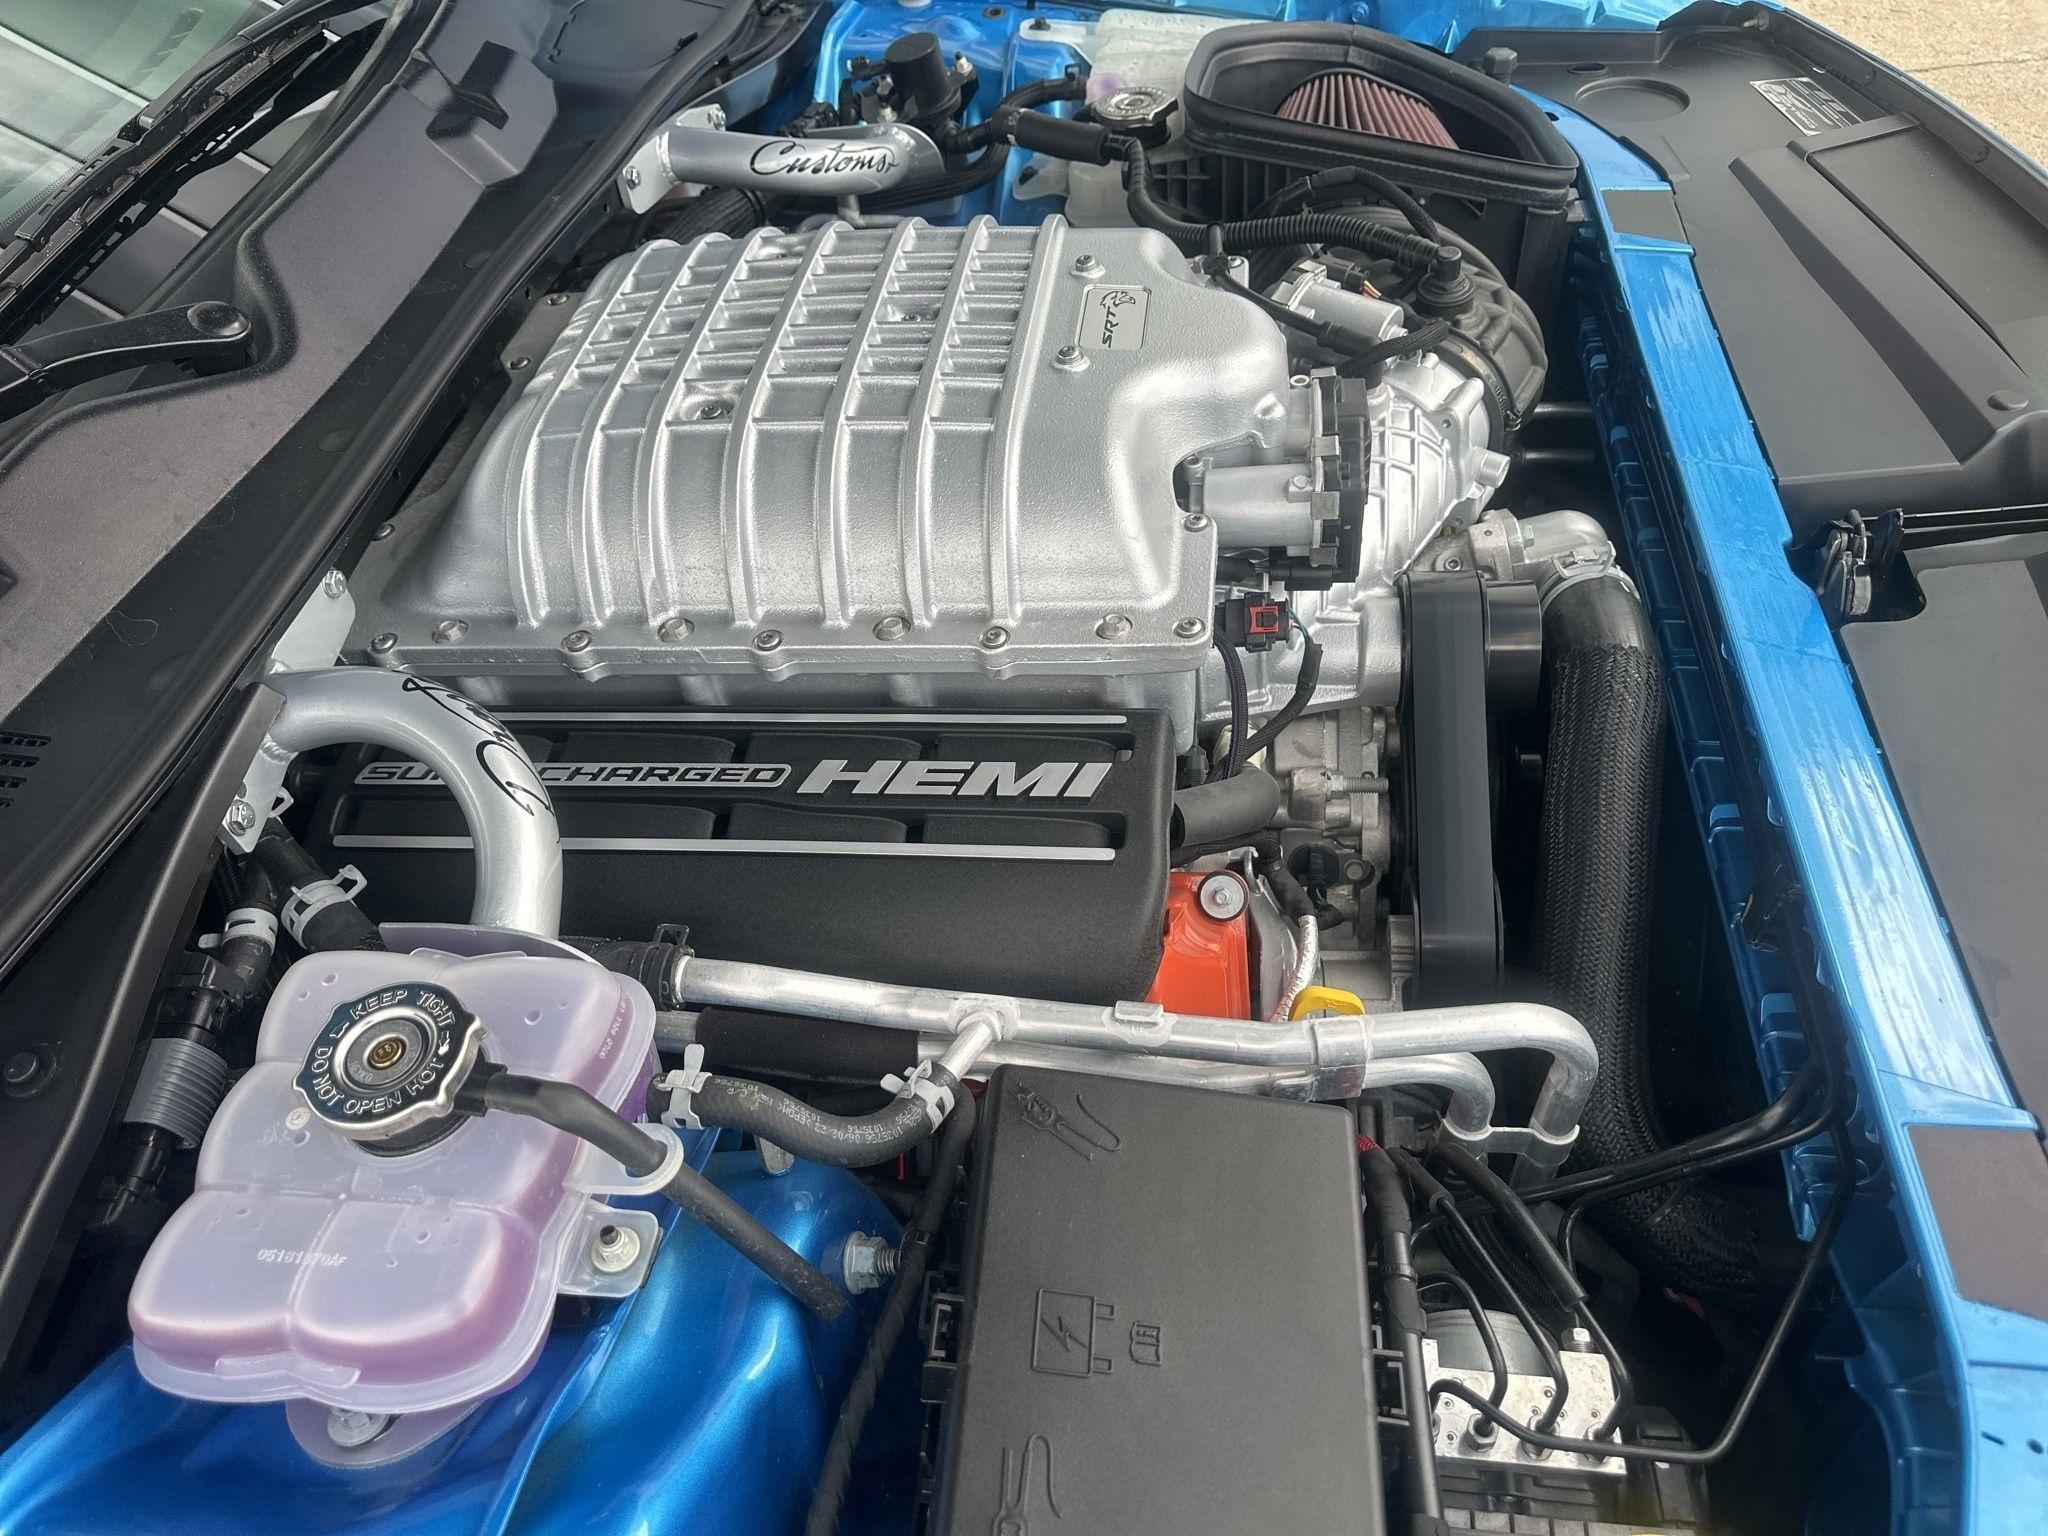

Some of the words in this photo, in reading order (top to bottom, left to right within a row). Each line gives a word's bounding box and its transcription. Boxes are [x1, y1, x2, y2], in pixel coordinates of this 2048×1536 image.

[750, 140, 899, 176] Customs
[1102, 306, 1119, 348] SRT
[361, 765, 788, 783] SUCHARGED
[796, 759, 1113, 798] HEMI
[350, 989, 408, 1019] KEEP
[416, 990, 456, 1026] TIGHT
[311, 1046, 333, 1073] DO
[406, 1057, 444, 1096] HOT
[312, 1073, 345, 1106] NOT
[343, 1089, 403, 1114] OPEN
